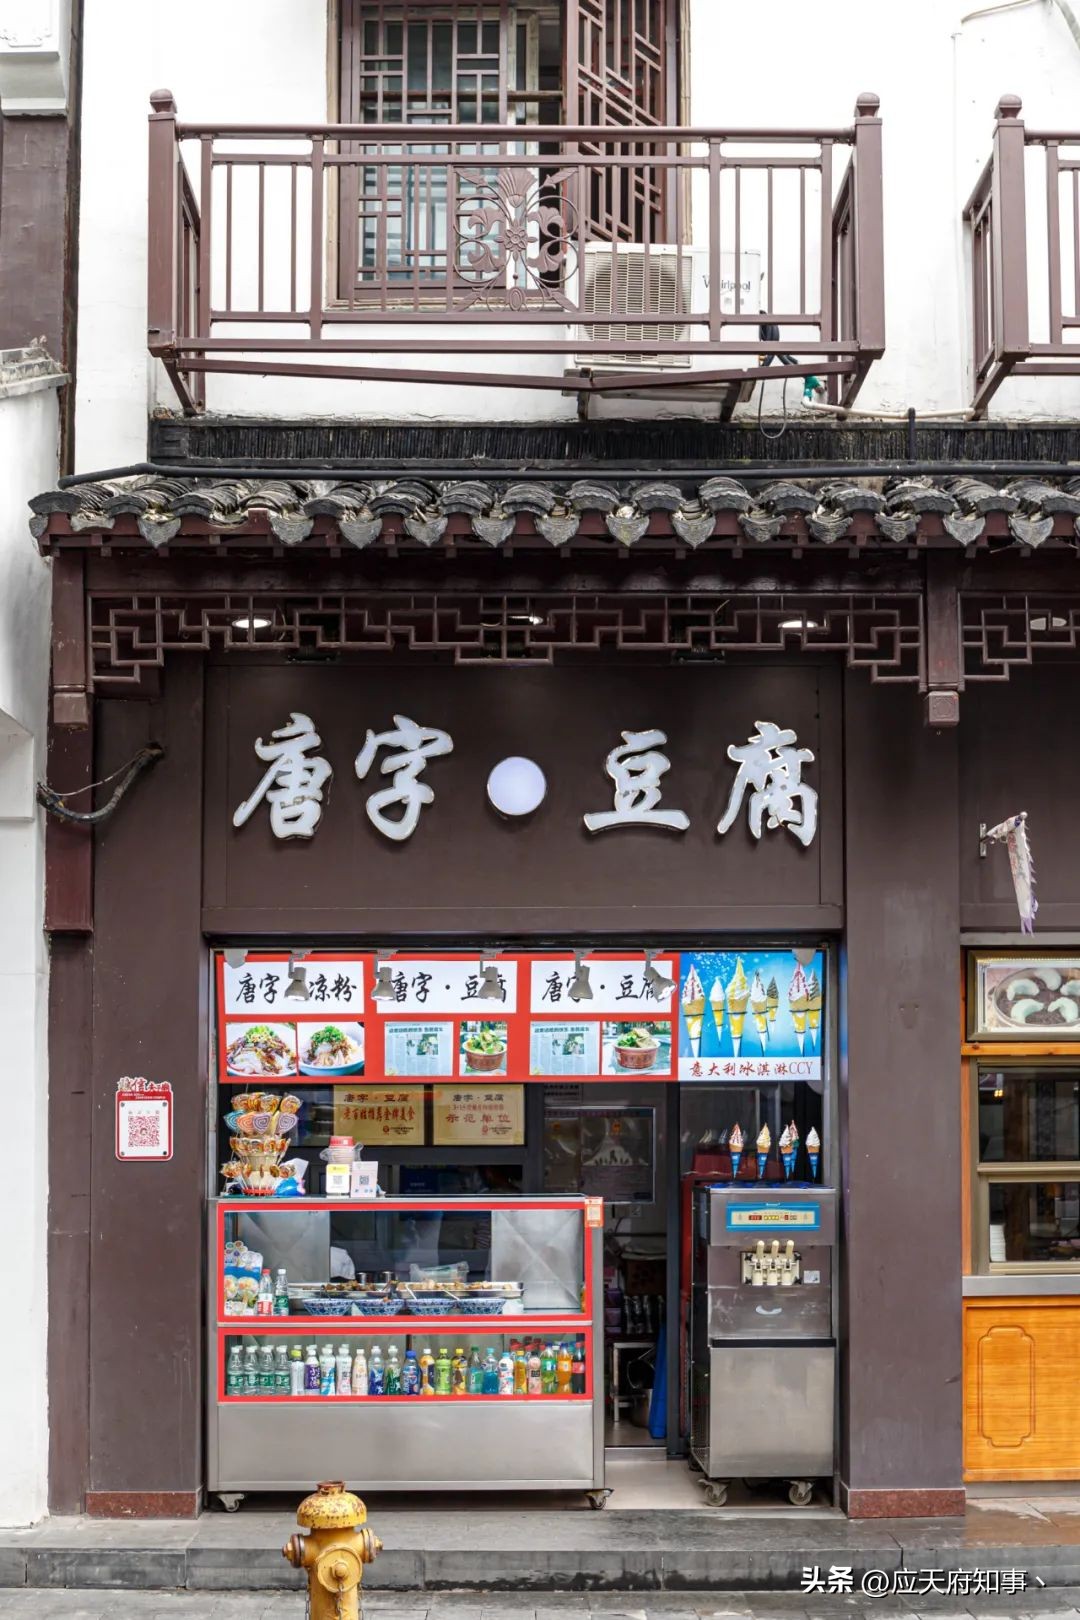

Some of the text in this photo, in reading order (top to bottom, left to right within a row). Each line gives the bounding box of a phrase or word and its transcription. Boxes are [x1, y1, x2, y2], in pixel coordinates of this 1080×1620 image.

[702, 275, 751, 291] Wirlpol
[235, 972, 357, 1004] 唐字凉粉
